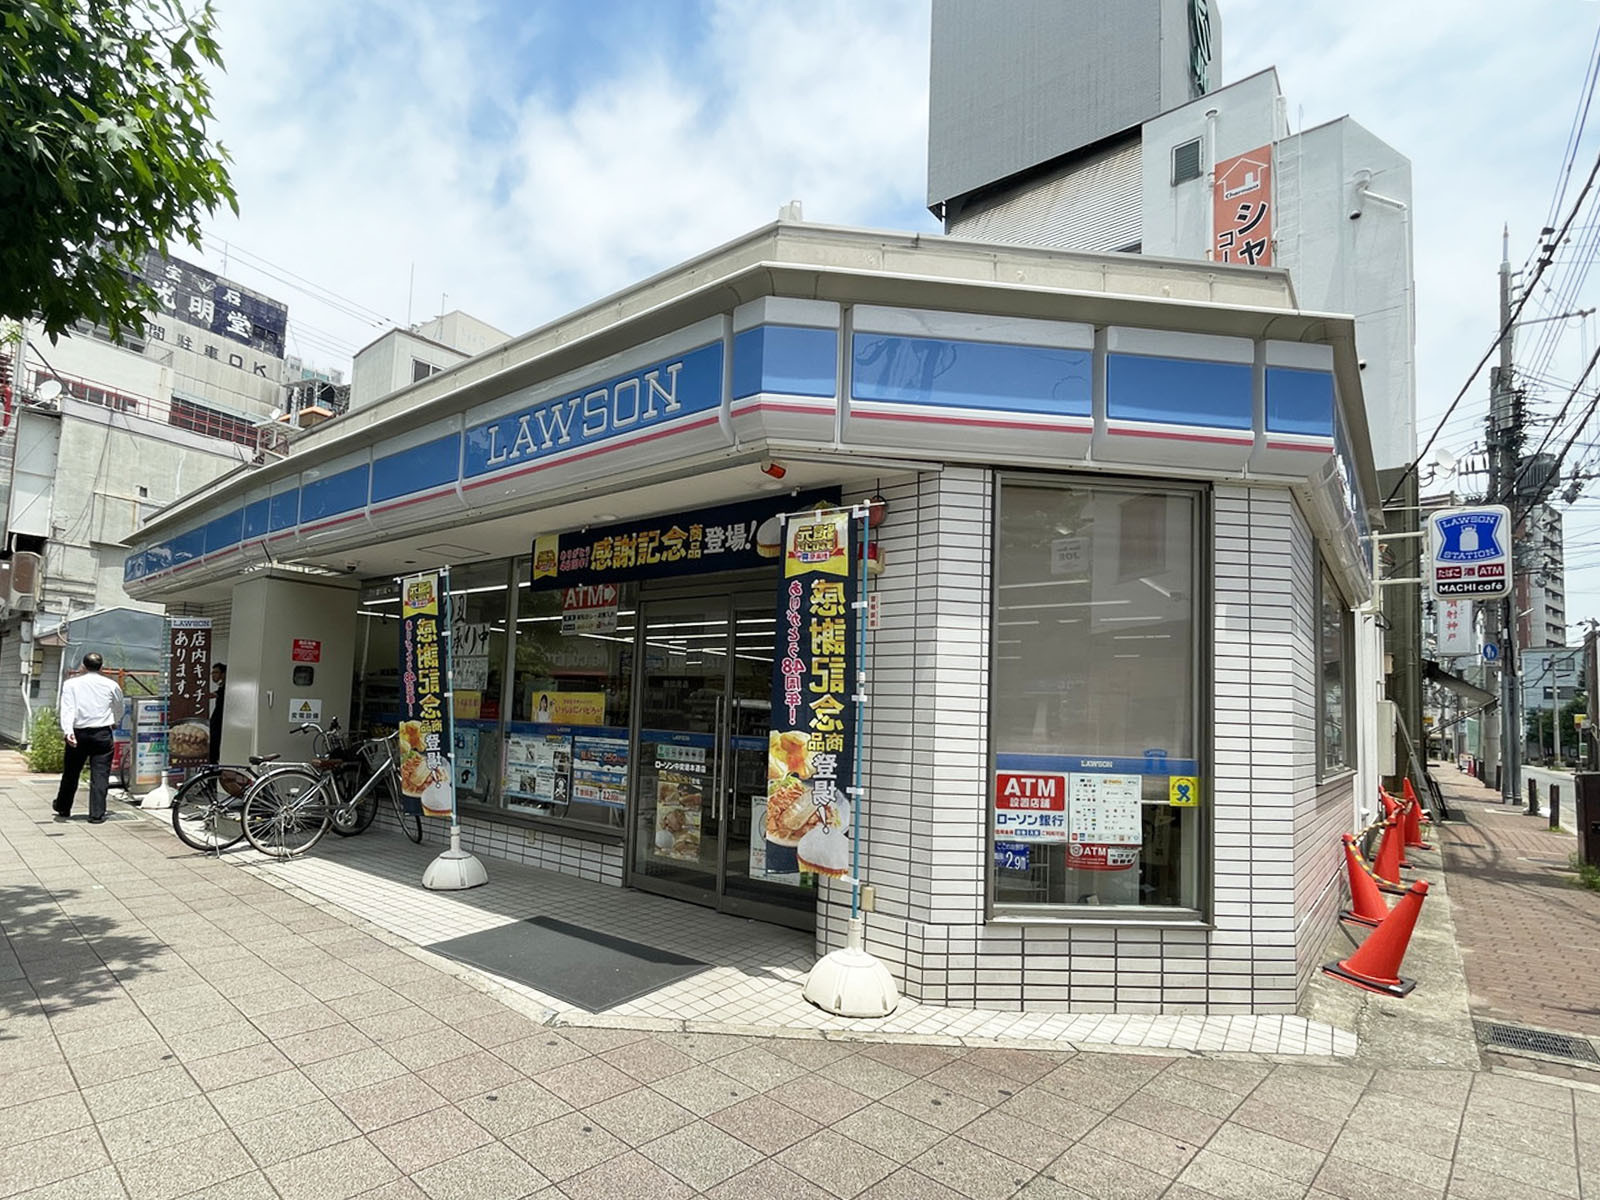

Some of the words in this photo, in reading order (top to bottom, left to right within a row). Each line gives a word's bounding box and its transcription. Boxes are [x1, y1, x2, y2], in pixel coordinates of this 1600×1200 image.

[487, 362, 682, 466] LAWSON
[1442, 515, 1495, 528] LAWSON
[1443, 548, 1495, 560] STATION
[1480, 566, 1503, 575] ATM
[1439, 584, 1476, 593] MACHI
[1478, 582, 1503, 591] café
[564, 584, 604, 609] ATM
[190, 630, 206, 715] 店内キッチン
[1081, 759, 1113, 768] LAWSON
[1004, 777, 1056, 797] ATM
[1009, 797, 1051, 809] 設置店舗
[997, 814, 1065, 828] ローソン銀行
[1084, 847, 1107, 857] ATM
